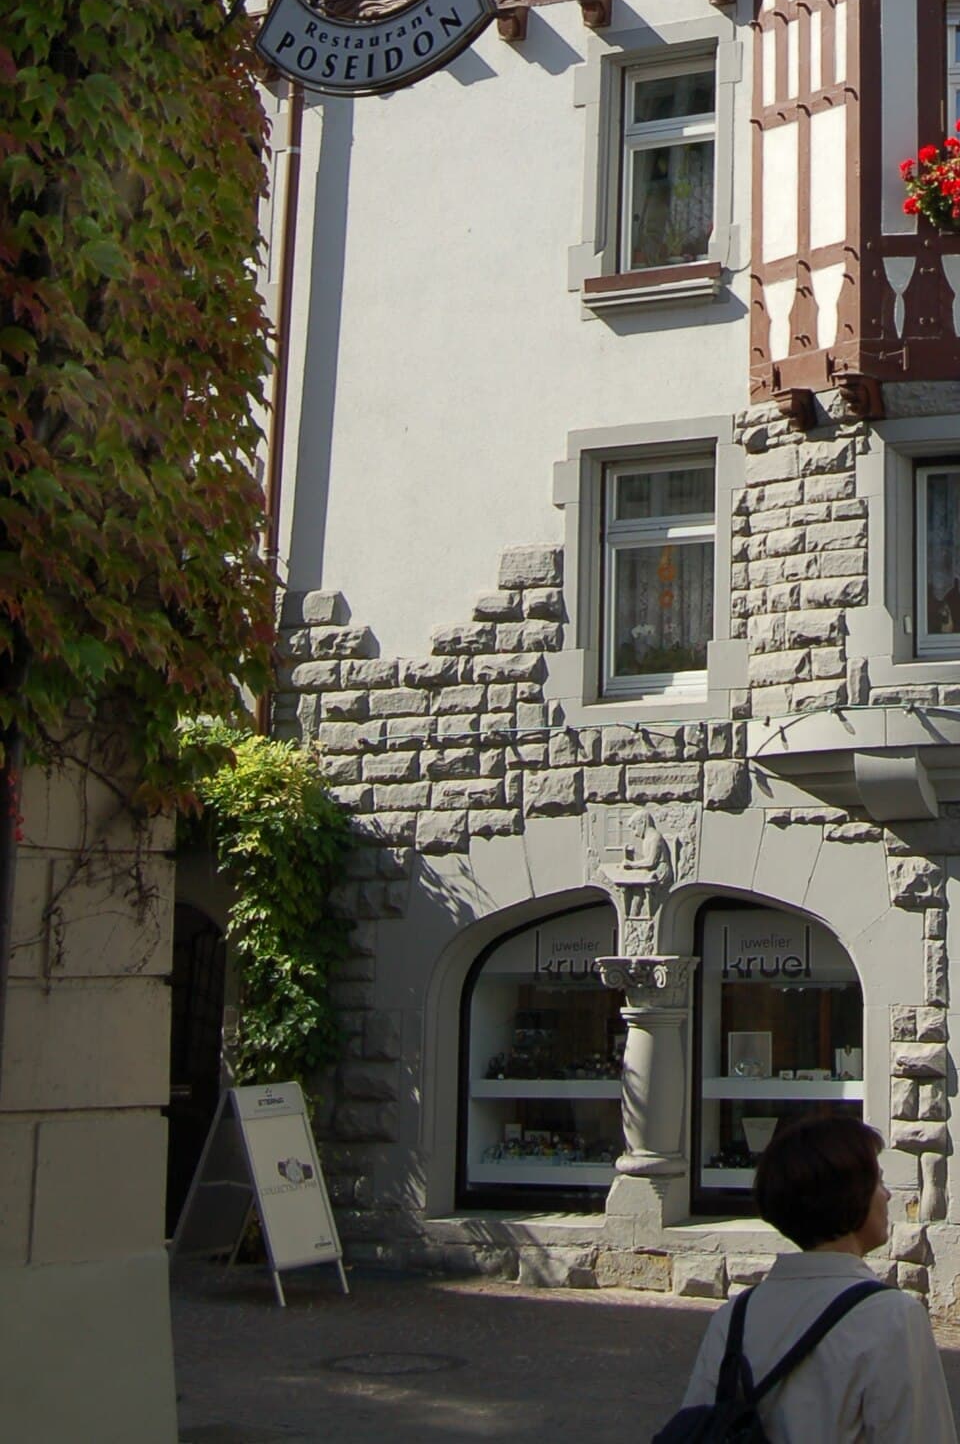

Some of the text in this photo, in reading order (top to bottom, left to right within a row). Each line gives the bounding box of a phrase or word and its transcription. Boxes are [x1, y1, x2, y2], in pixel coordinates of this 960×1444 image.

[276, 7, 464, 80] POSEIDON
[305, 5, 434, 49] Restaurant
[551, 937, 600, 955] juwelier
[722, 925, 811, 979] kruel
[740, 933, 792, 953] juwelier
